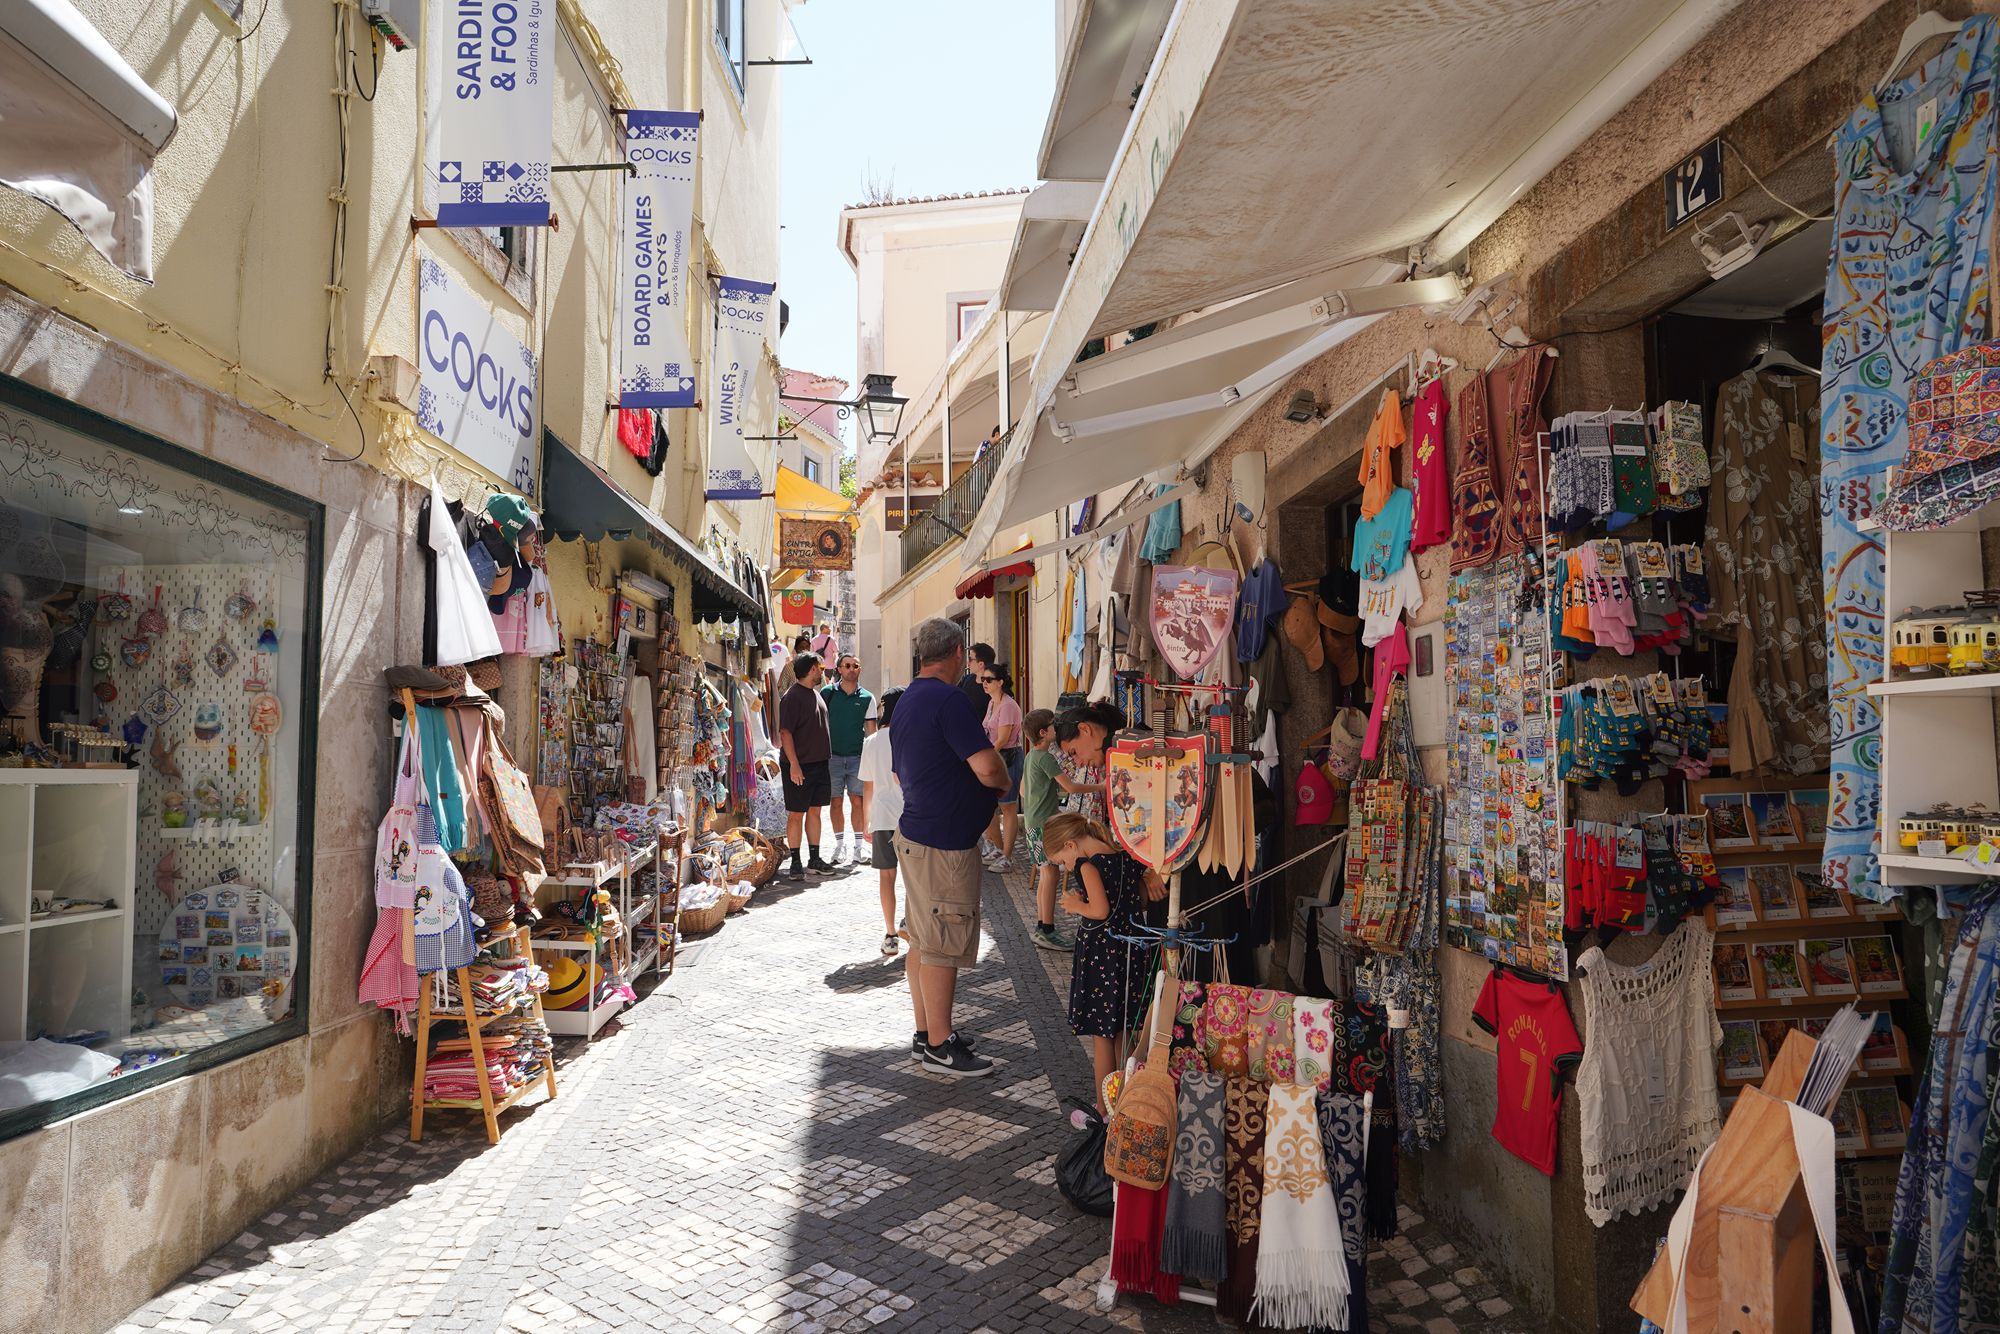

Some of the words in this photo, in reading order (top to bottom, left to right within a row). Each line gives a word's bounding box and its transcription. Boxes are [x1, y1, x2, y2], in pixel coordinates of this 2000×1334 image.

[491, 0, 518, 63] FOO
[528, 21, 540, 29] &
[526, 31, 540, 85] Sardinhas
[490, 72, 516, 91] &
[630, 147, 692, 164] COCKS
[1676, 155, 1706, 220] 12
[635, 195, 652, 269] GAMES
[672, 230, 683, 273] Brinquedos
[656, 233, 669, 289] TOYS
[633, 274, 651, 346] BOARD
[657, 292, 671, 306] &
[721, 305, 764, 323] COCKS
[424, 309, 533, 438] COCKS
[1600, 460, 1609, 511] PORTUGAL
[785, 540, 817, 548] CINTRA
[786, 549, 817, 557] ANTIGA
[1166, 643, 1186, 653] Sintra
[1624, 875, 1637, 891] 7
[1621, 908, 1634, 924] 7
[1507, 1015, 1548, 1057] RONALDO
[1519, 1047, 1538, 1112] 7
